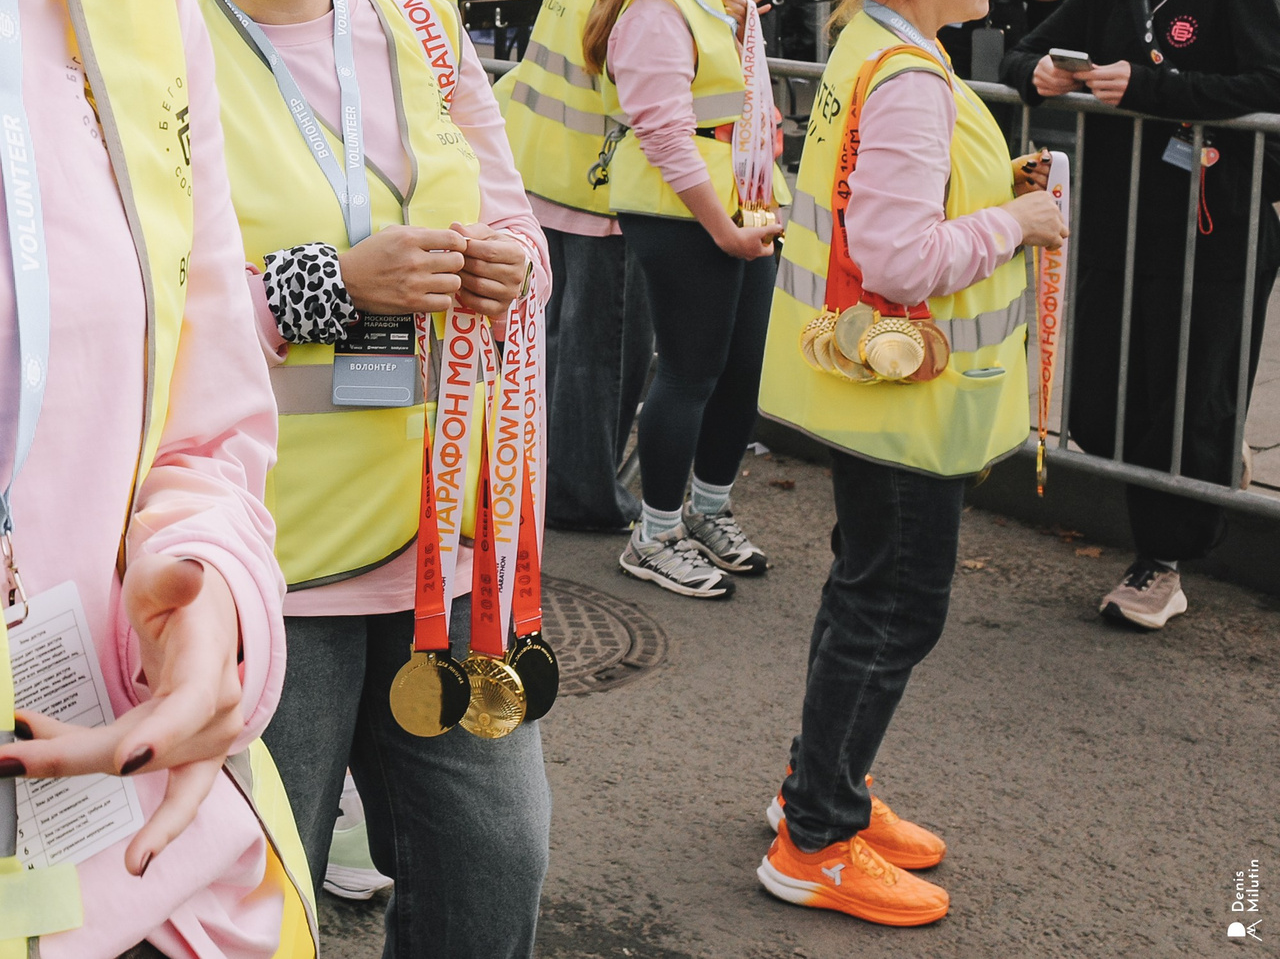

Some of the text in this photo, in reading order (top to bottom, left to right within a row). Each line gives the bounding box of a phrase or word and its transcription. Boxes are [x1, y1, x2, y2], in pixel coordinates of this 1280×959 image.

[744, 6, 756, 90] MARATHON
[290, 98, 330, 159] ВОЛОНТЁР
[346, 105, 361, 169] VOLUNTEER
[739, 90, 754, 153] MOSCOW
[2, 114, 42, 272] VOLUNTEER
[350, 363, 397, 372] ВОЛОНТЁР
[435, 393, 469, 553] МАРАФОН
[493, 416, 519, 544] MOSCOW
